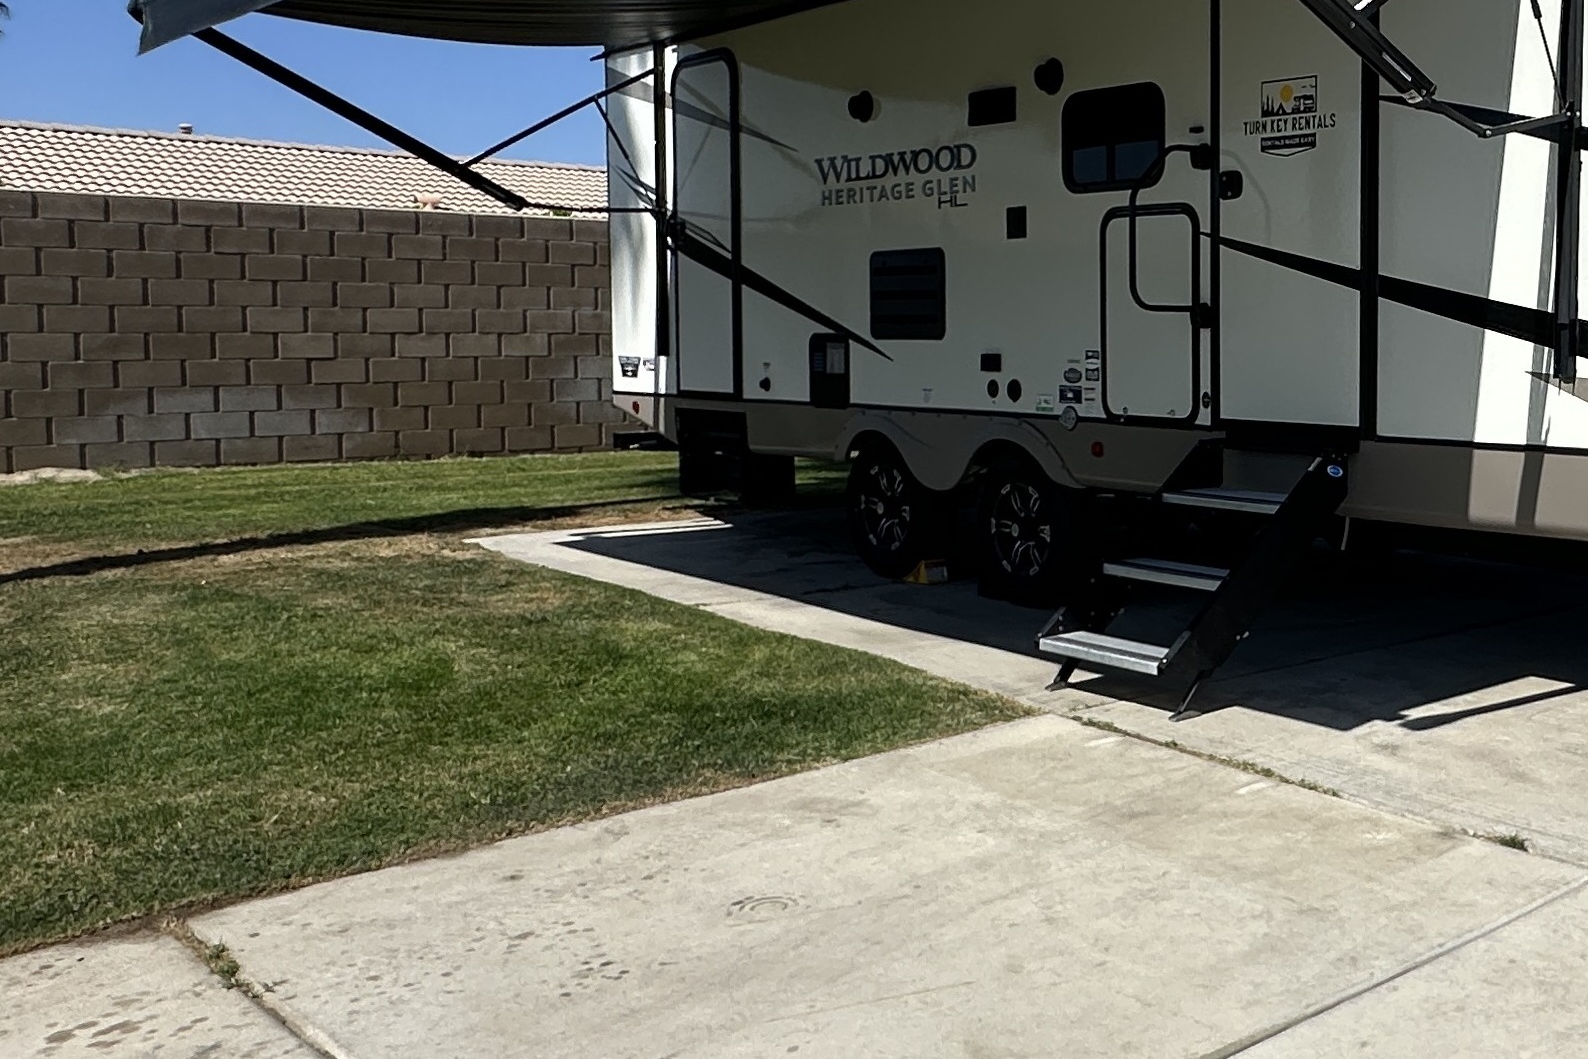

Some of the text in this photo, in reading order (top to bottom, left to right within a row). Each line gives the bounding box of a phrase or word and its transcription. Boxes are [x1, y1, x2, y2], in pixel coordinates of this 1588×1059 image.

[1243, 113, 1336, 136] TURN KEY RENTALS
[821, 174, 977, 206] HERITAGE GLEN
[937, 194, 969, 209] HL
